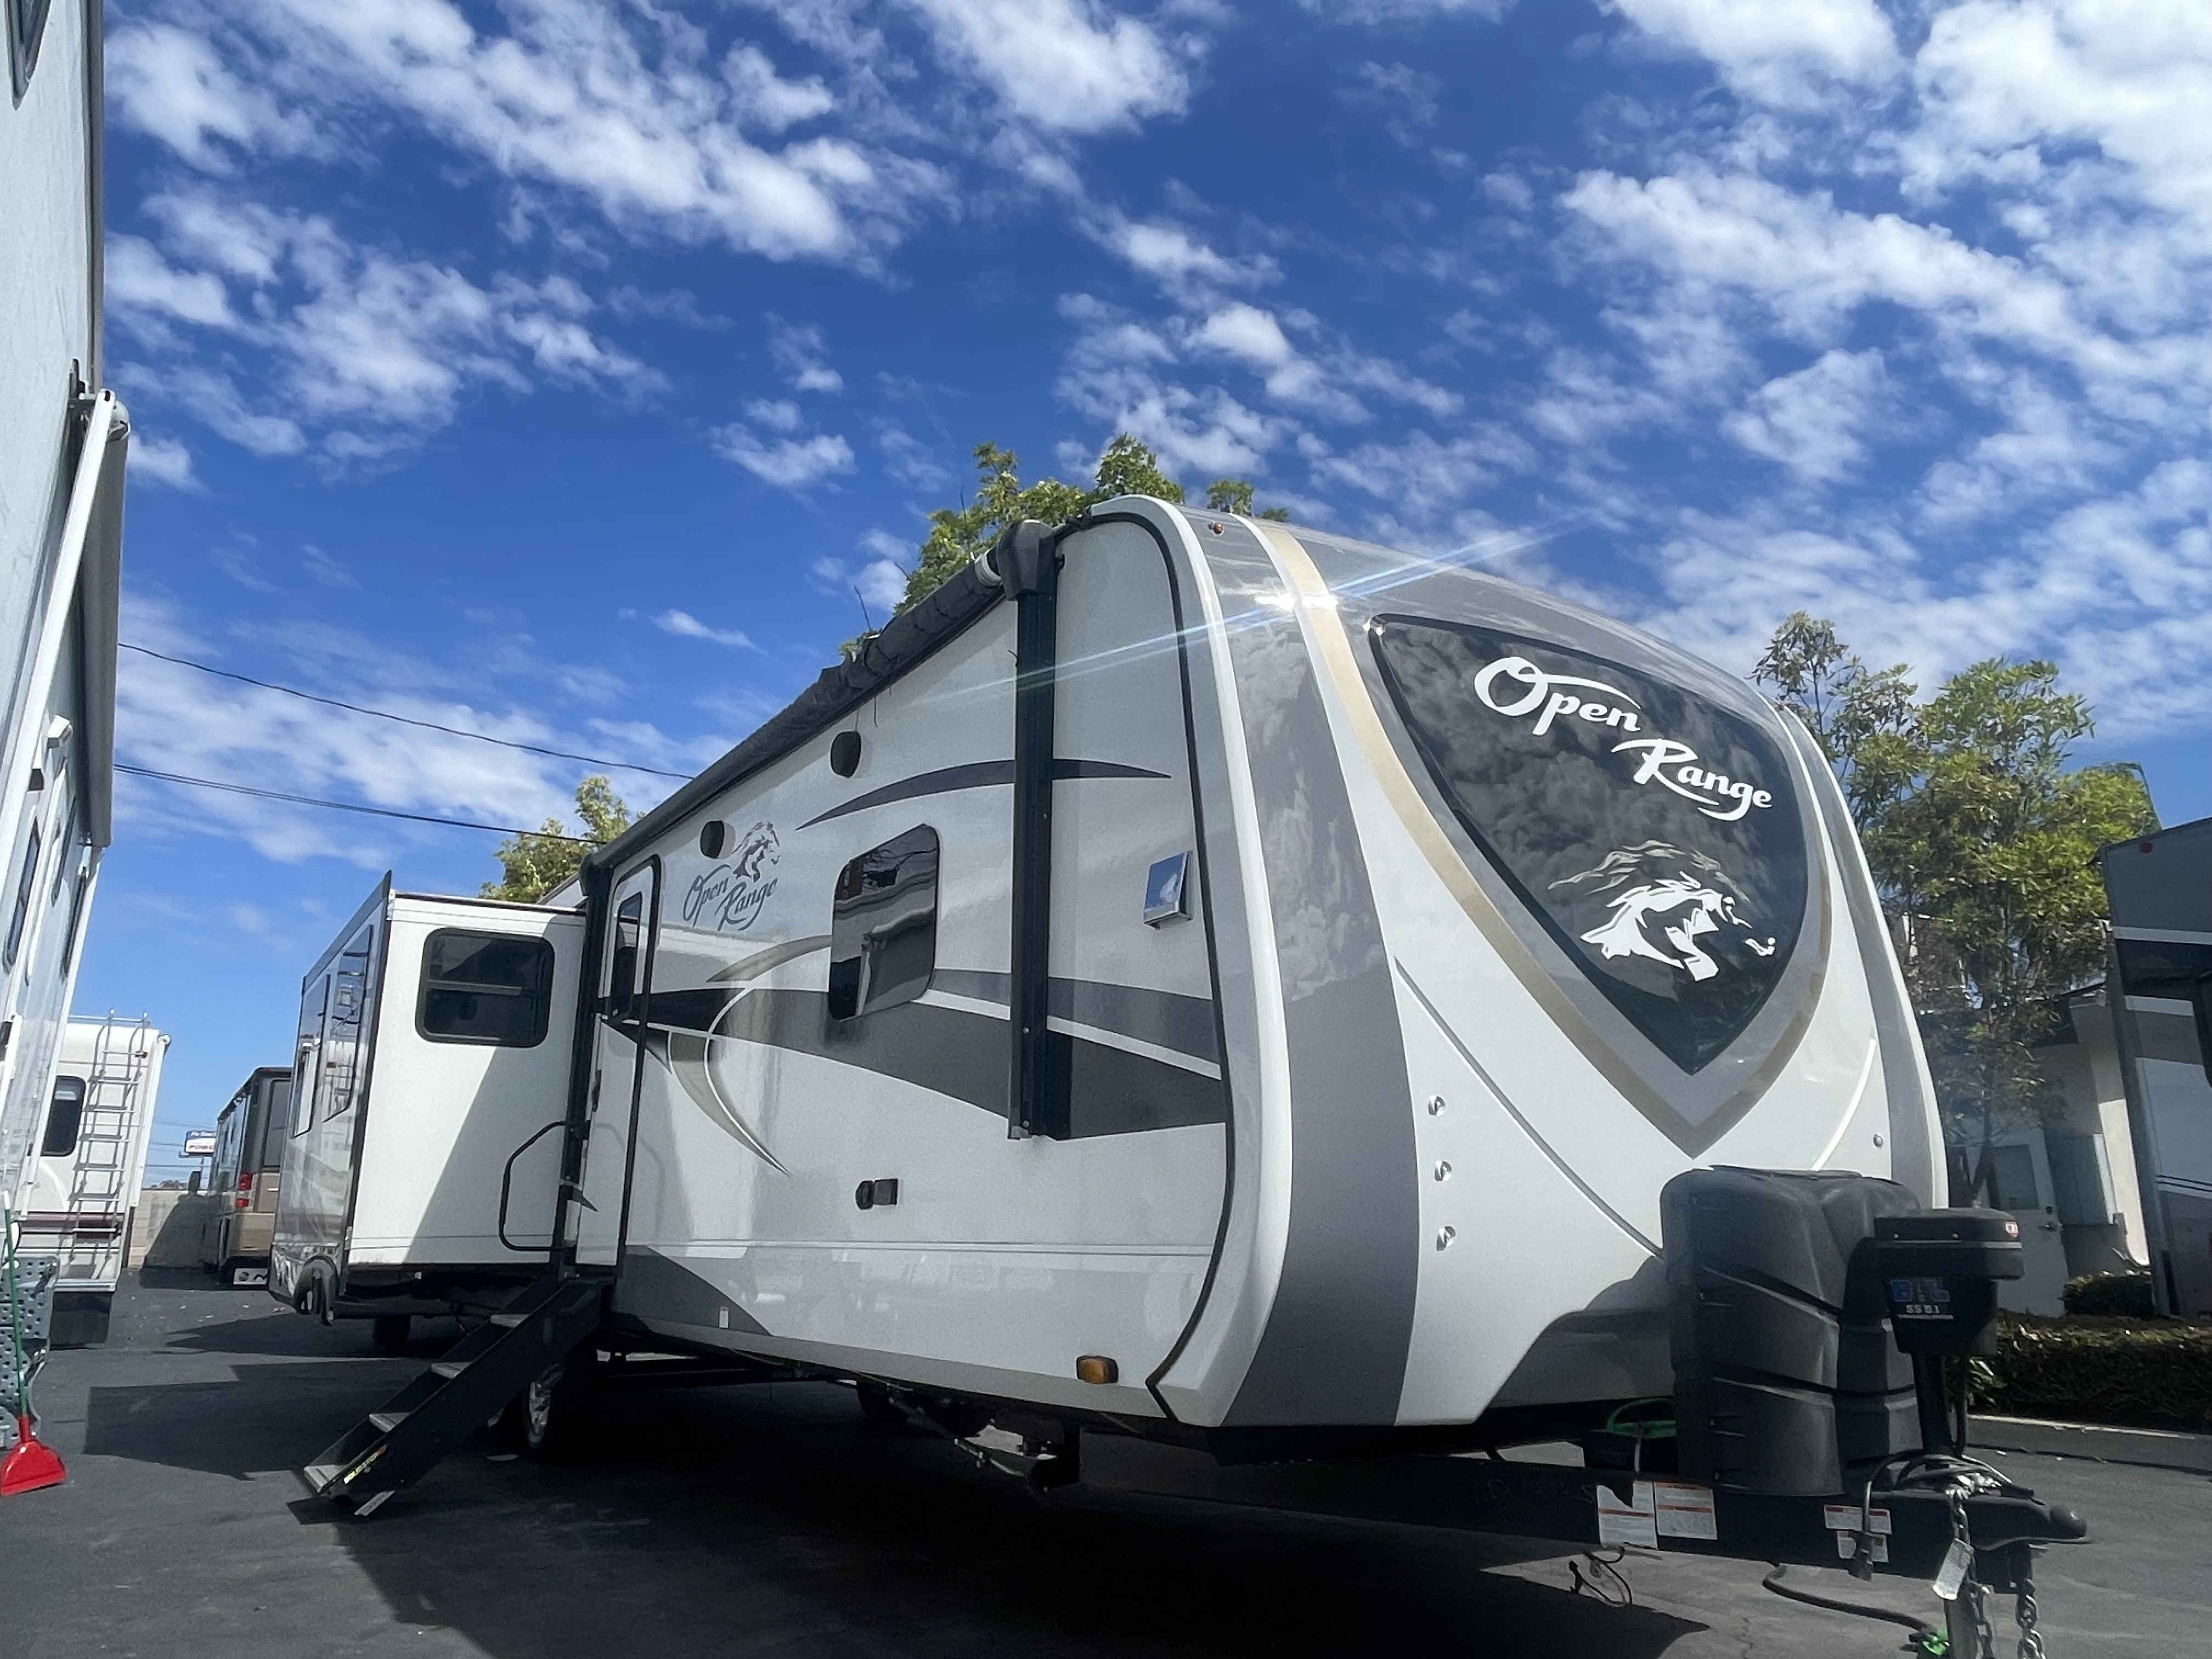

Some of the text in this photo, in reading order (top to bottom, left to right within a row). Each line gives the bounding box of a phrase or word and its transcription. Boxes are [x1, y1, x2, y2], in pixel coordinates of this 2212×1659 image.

[1474, 657, 1641, 735] Open
[1611, 738, 1772, 821] Range
[683, 864, 731, 927] Open
[714, 878, 778, 932] Range
